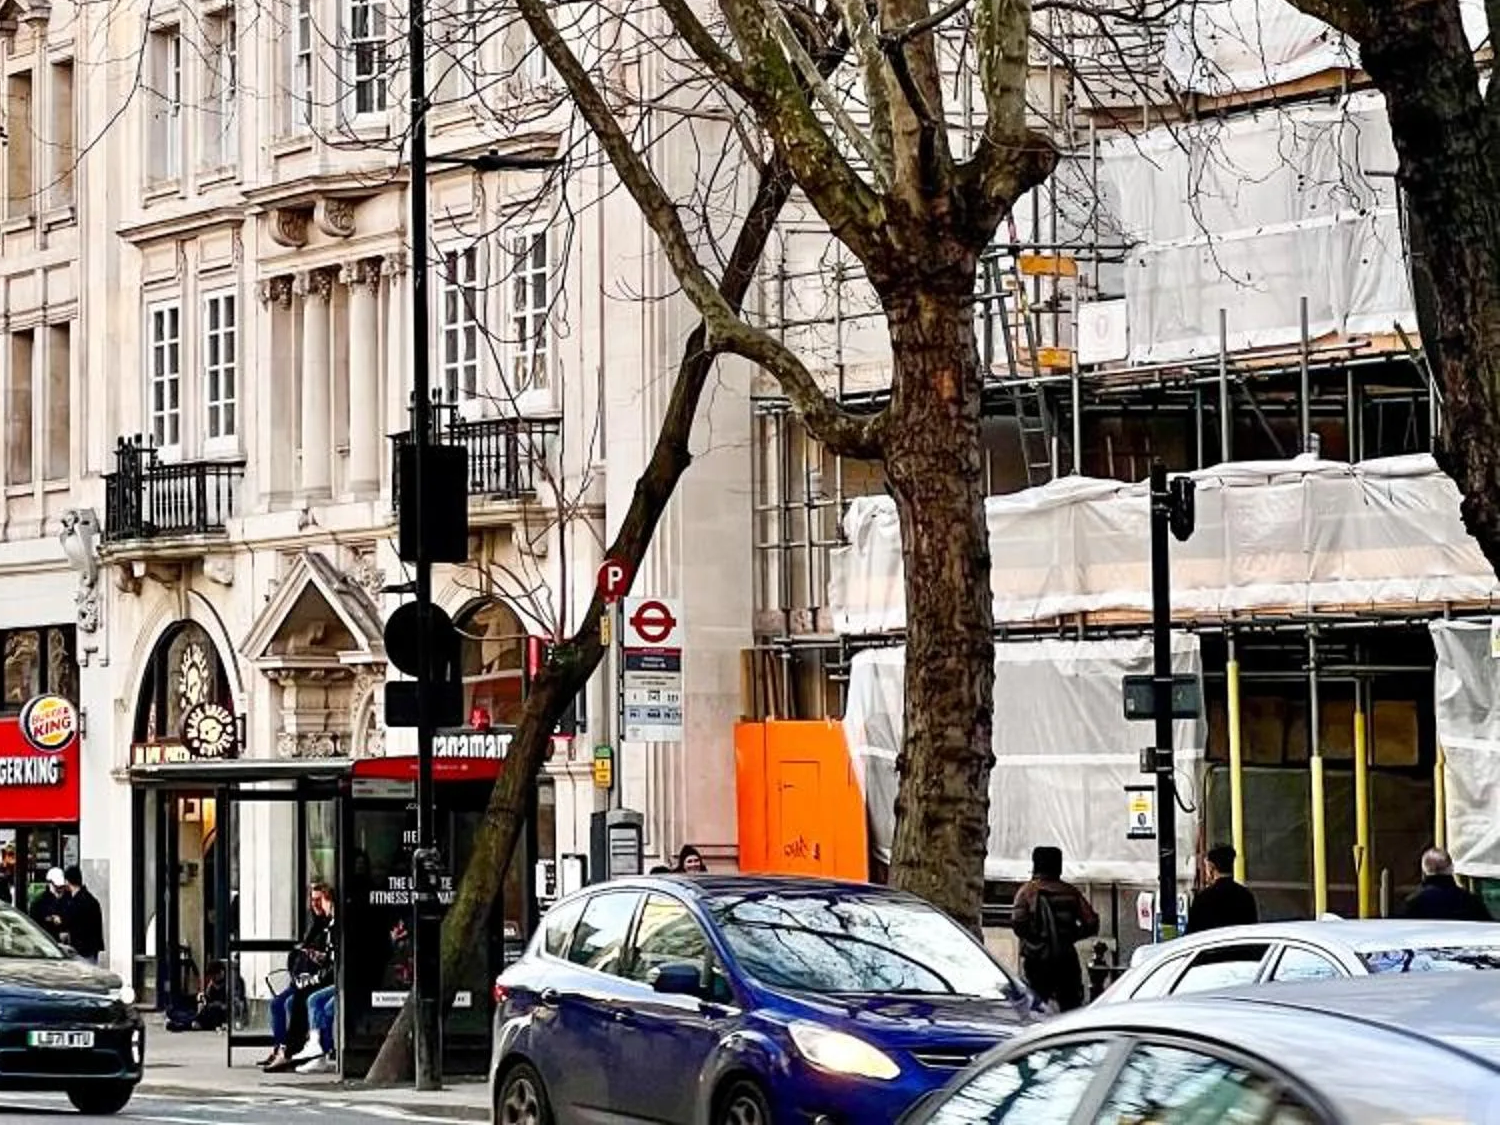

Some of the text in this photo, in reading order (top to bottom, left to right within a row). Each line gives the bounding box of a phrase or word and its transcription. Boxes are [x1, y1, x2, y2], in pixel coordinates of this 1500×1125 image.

[607, 567, 623, 591] P
[33, 716, 72, 738] KING
[23, 755, 59, 785] KING
[388, 876, 407, 890] THE
[369, 890, 409, 905] FITNESS
